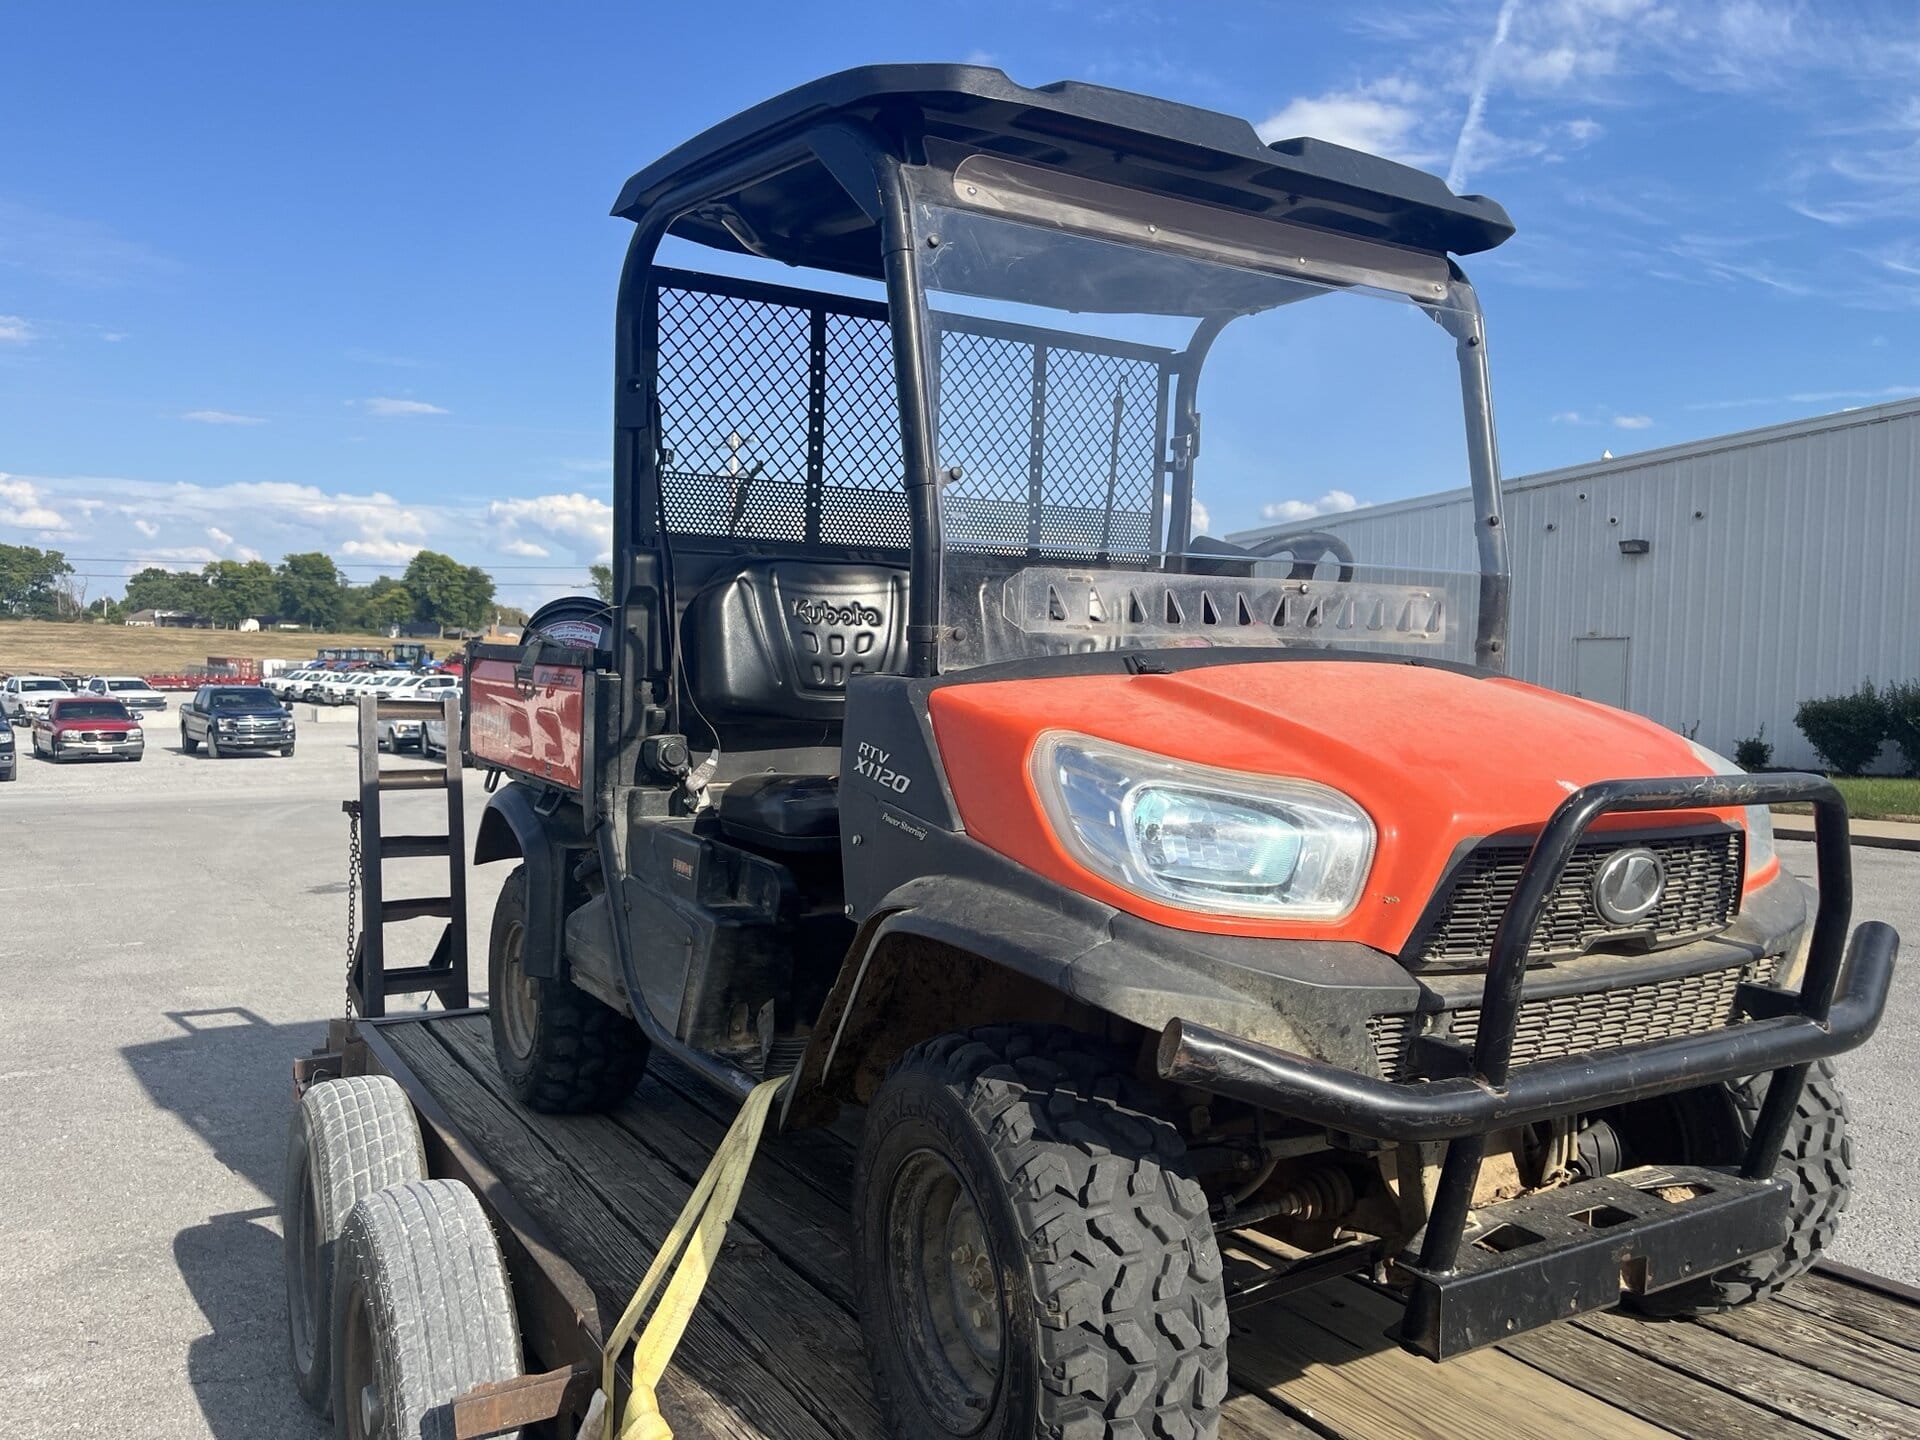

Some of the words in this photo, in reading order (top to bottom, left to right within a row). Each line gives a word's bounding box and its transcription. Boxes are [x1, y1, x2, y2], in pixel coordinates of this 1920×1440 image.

[792, 599, 883, 627] Kubota
[540, 671, 577, 687] DIESEL
[859, 741, 890, 764] RTV
[854, 756, 911, 793] X1120
[882, 812, 901, 826] Power
[900, 821, 928, 841] Steering
